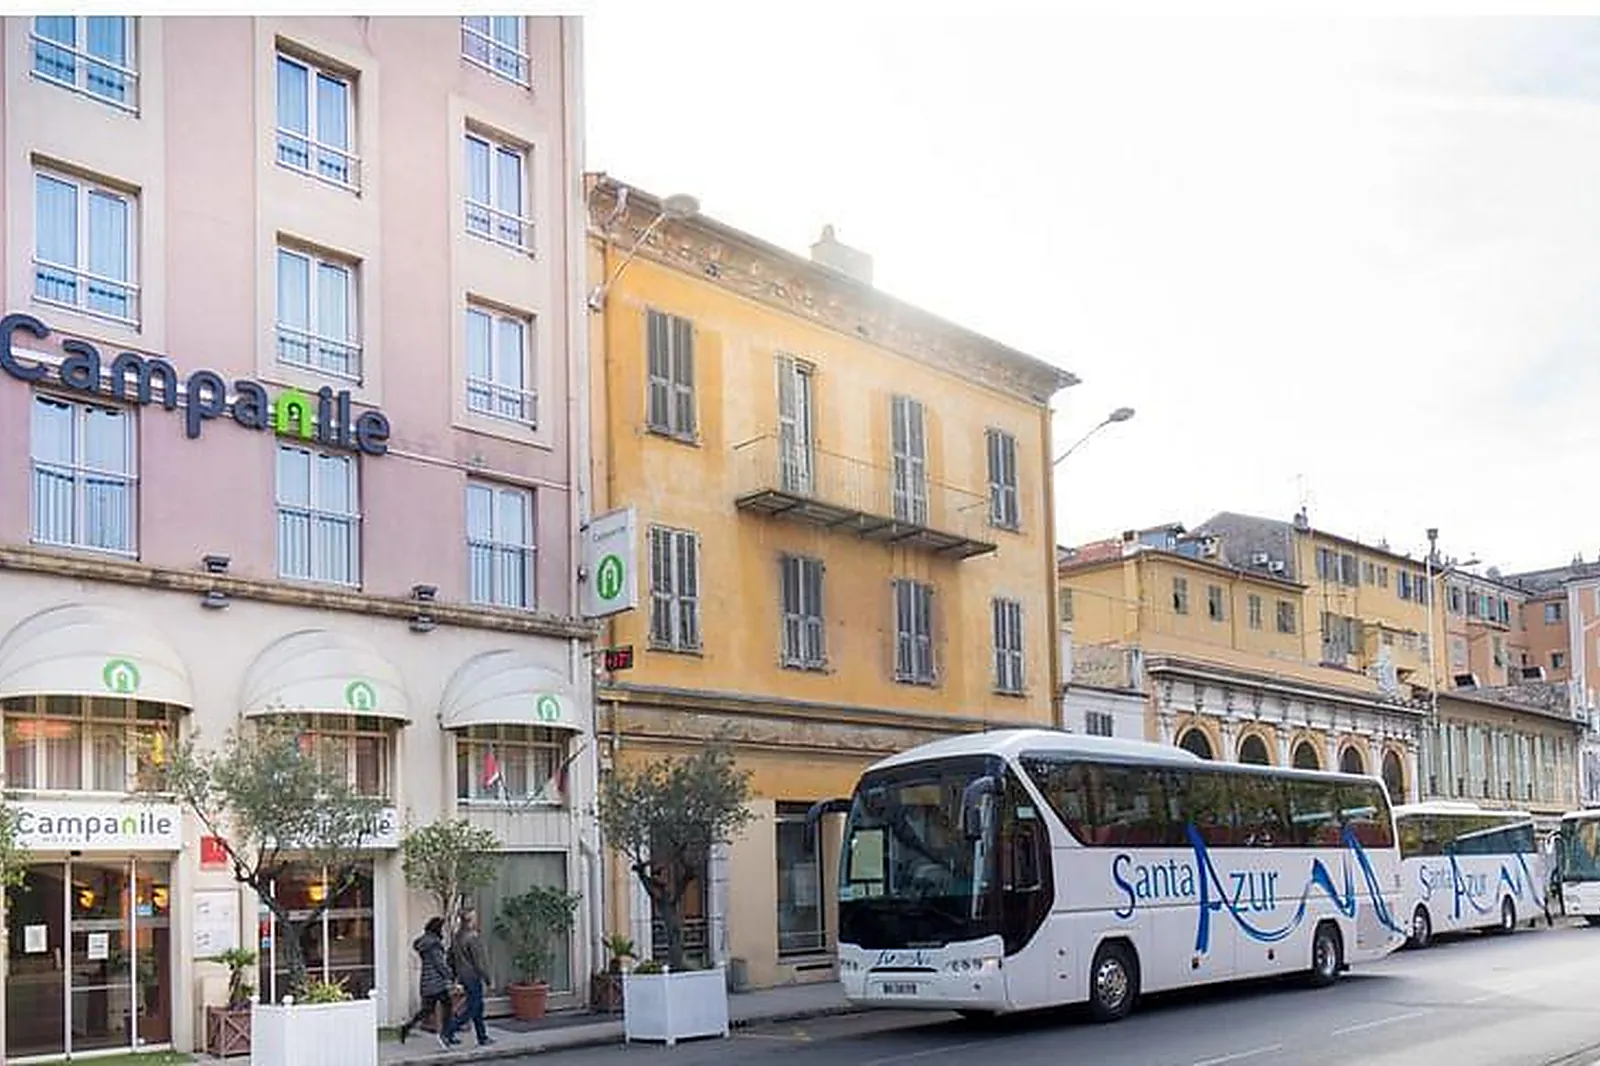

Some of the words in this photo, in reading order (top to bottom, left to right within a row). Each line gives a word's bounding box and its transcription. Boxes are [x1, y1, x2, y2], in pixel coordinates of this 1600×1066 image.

[0, 313, 390, 455] Campanile
[17, 812, 172, 842] Campanile
[1113, 854, 1196, 919] Santa
[1186, 822, 1278, 954] Azur
